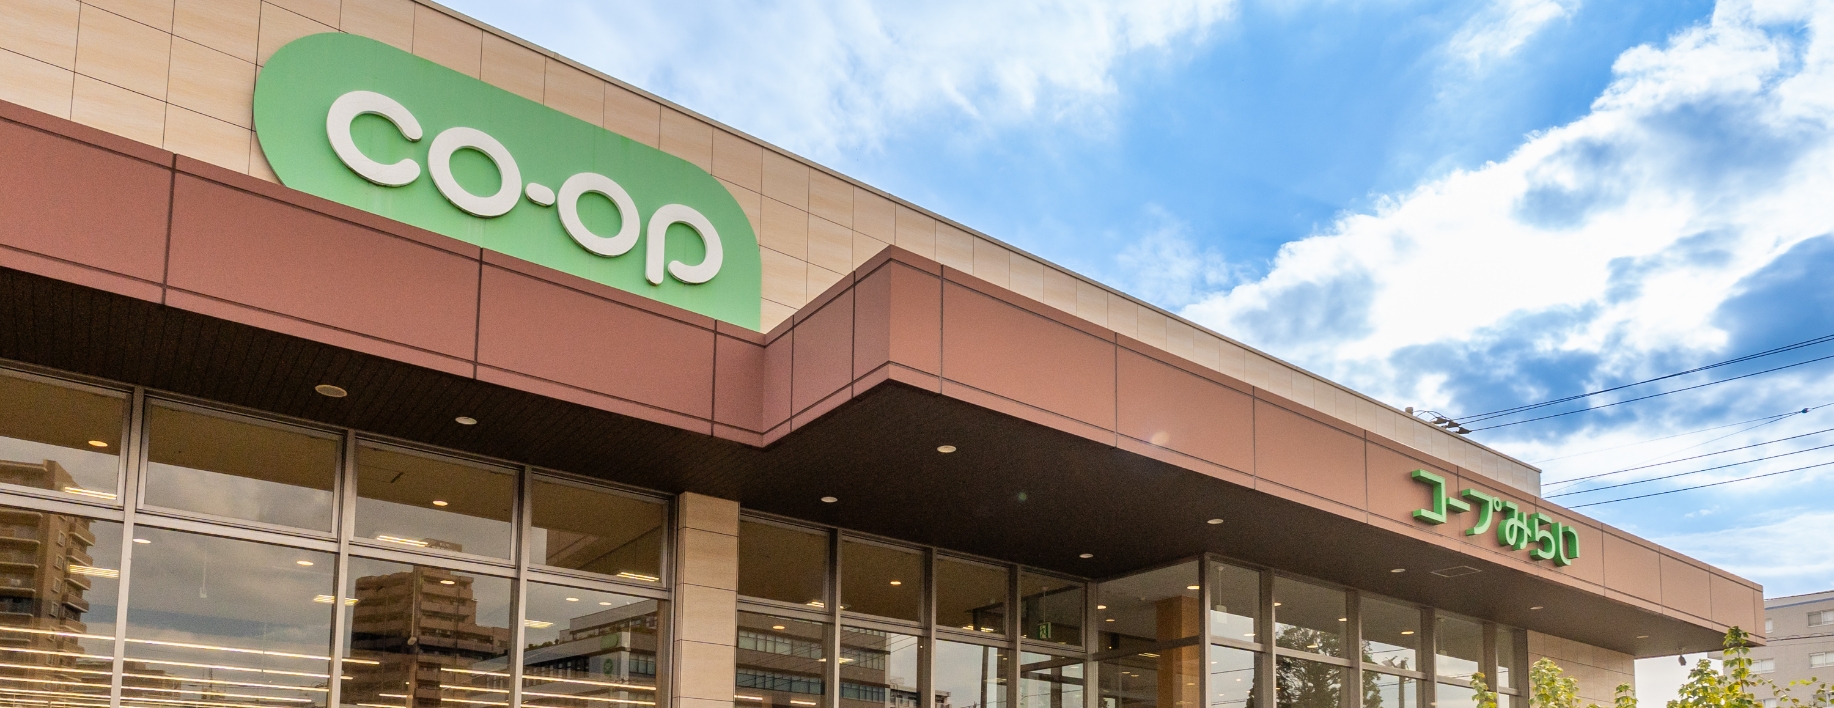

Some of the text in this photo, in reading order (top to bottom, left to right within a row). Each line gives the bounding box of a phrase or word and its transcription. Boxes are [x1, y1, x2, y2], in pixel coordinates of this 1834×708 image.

[1412, 469, 1579, 566] コープみらい
